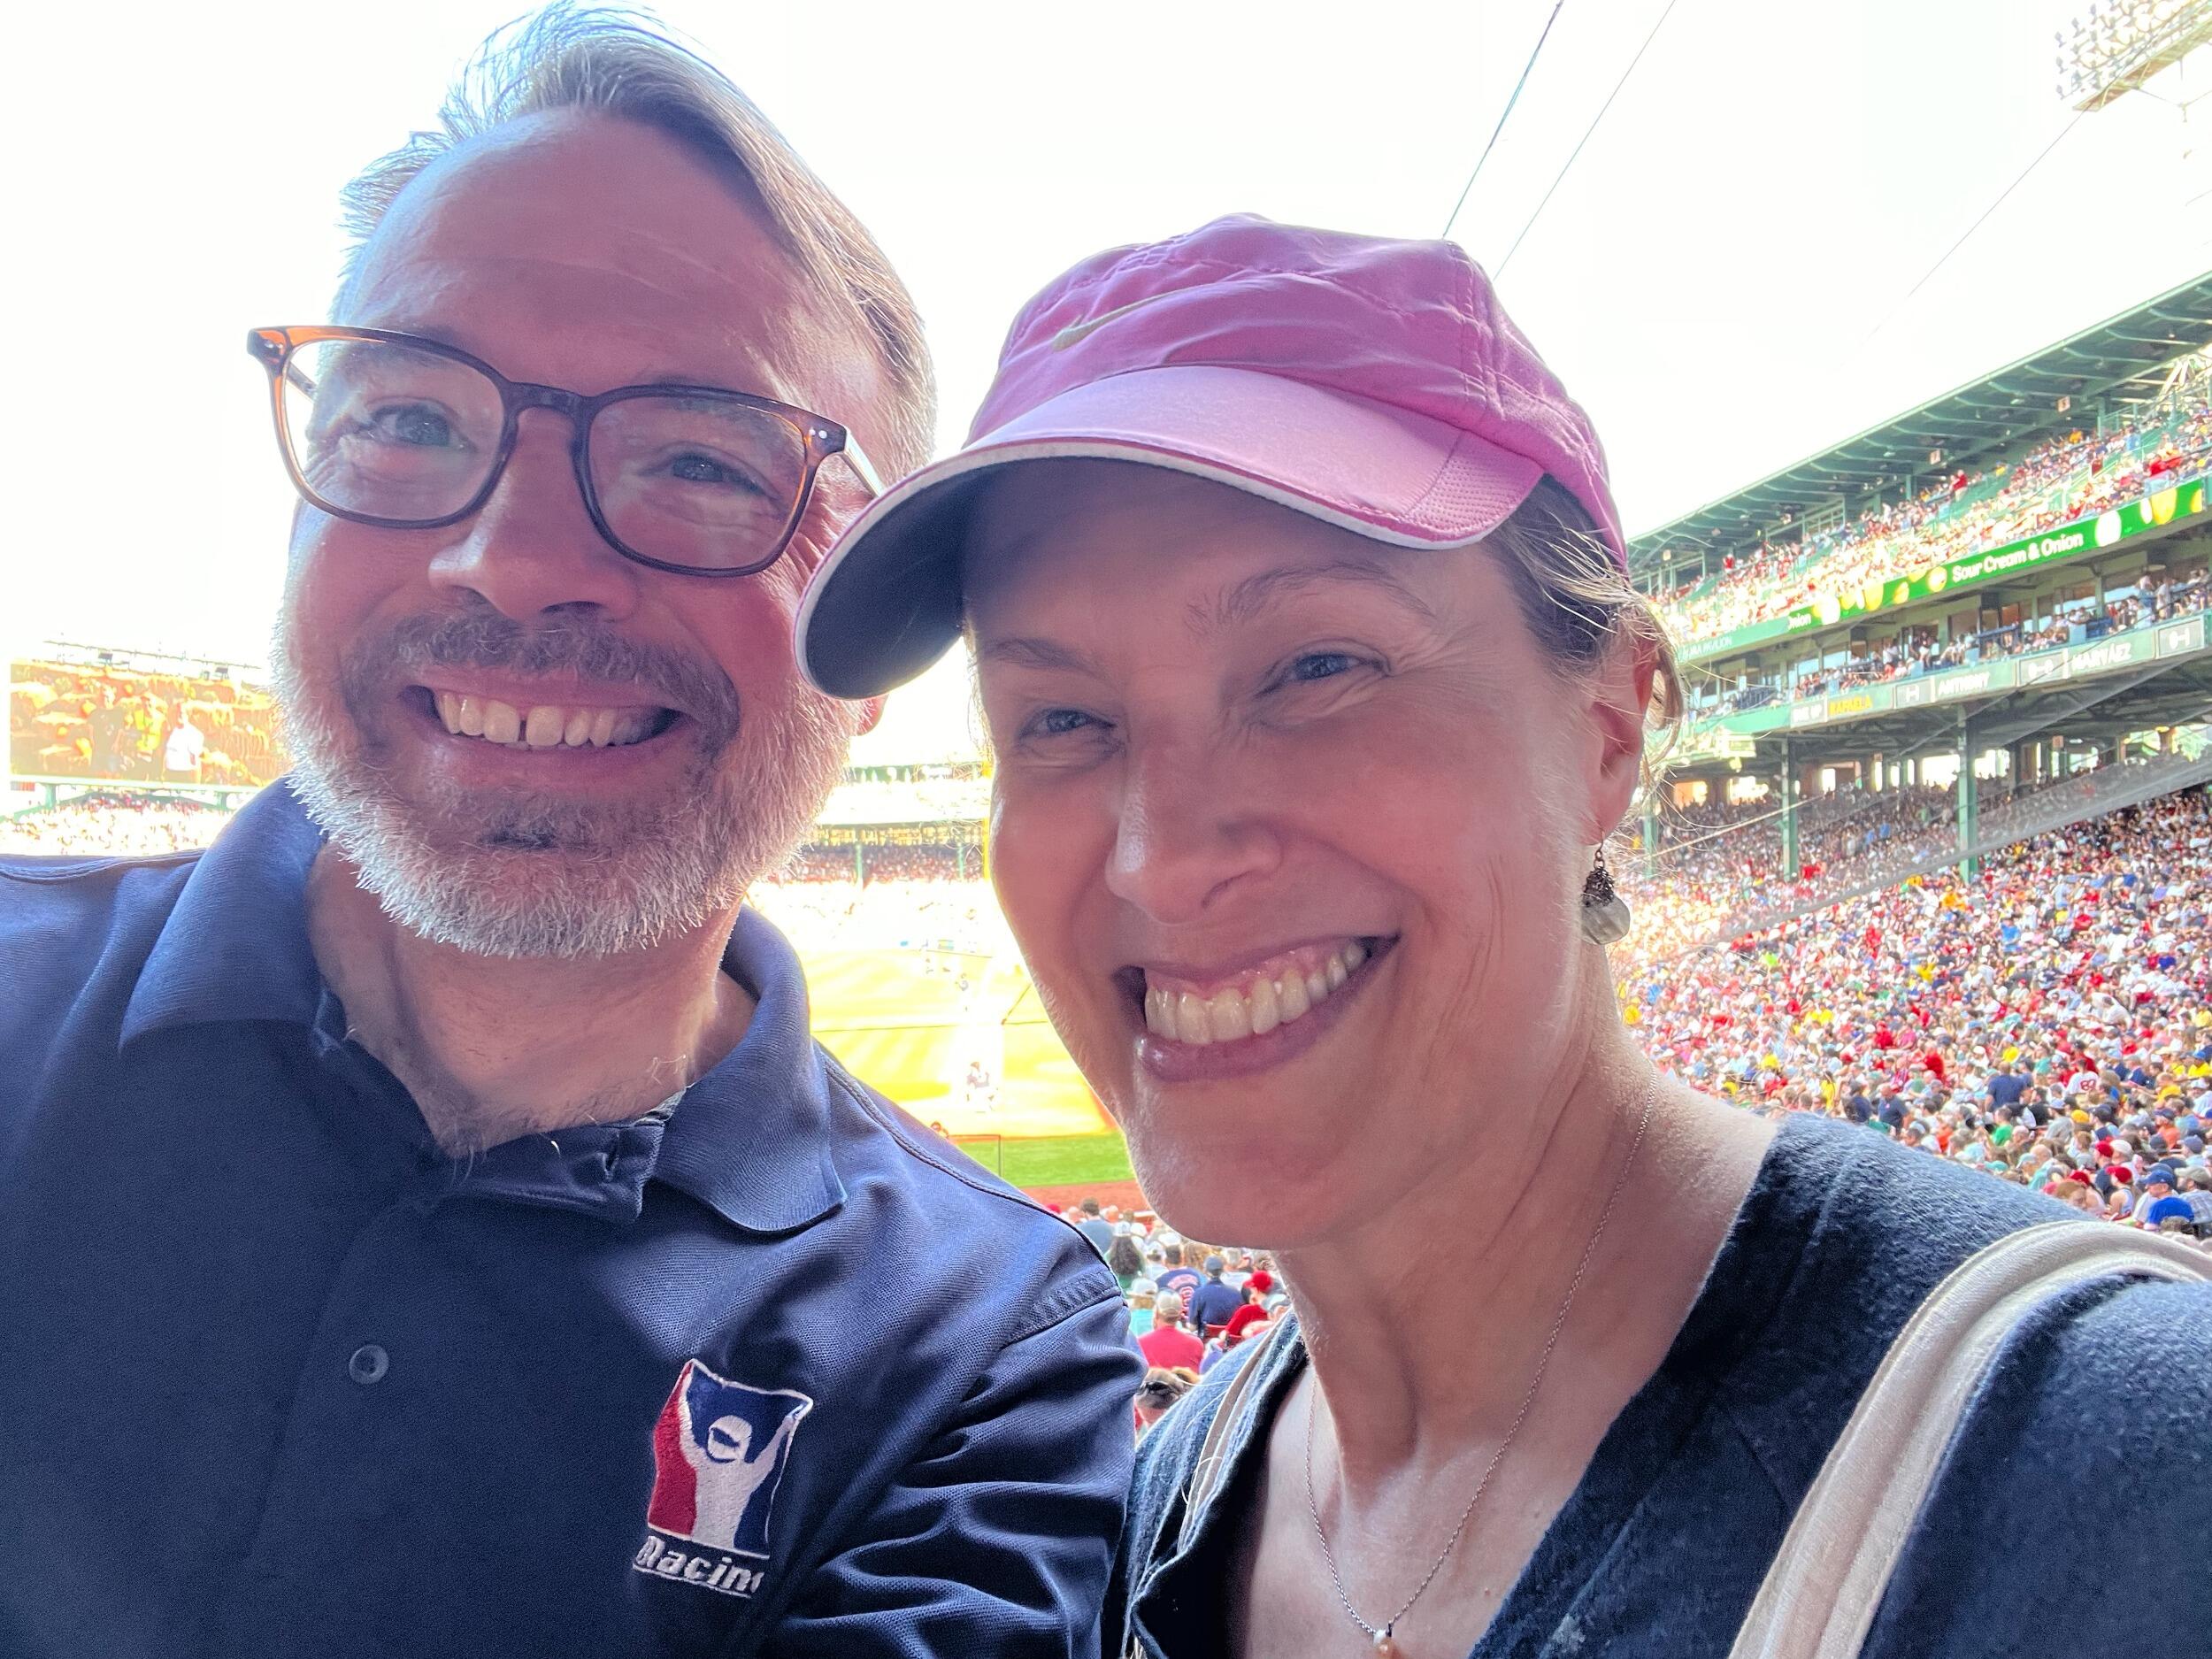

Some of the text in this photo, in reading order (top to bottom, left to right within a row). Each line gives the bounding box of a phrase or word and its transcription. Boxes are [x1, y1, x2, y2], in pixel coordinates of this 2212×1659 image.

[1953, 533, 2084, 583] Sour Cream & Onion
